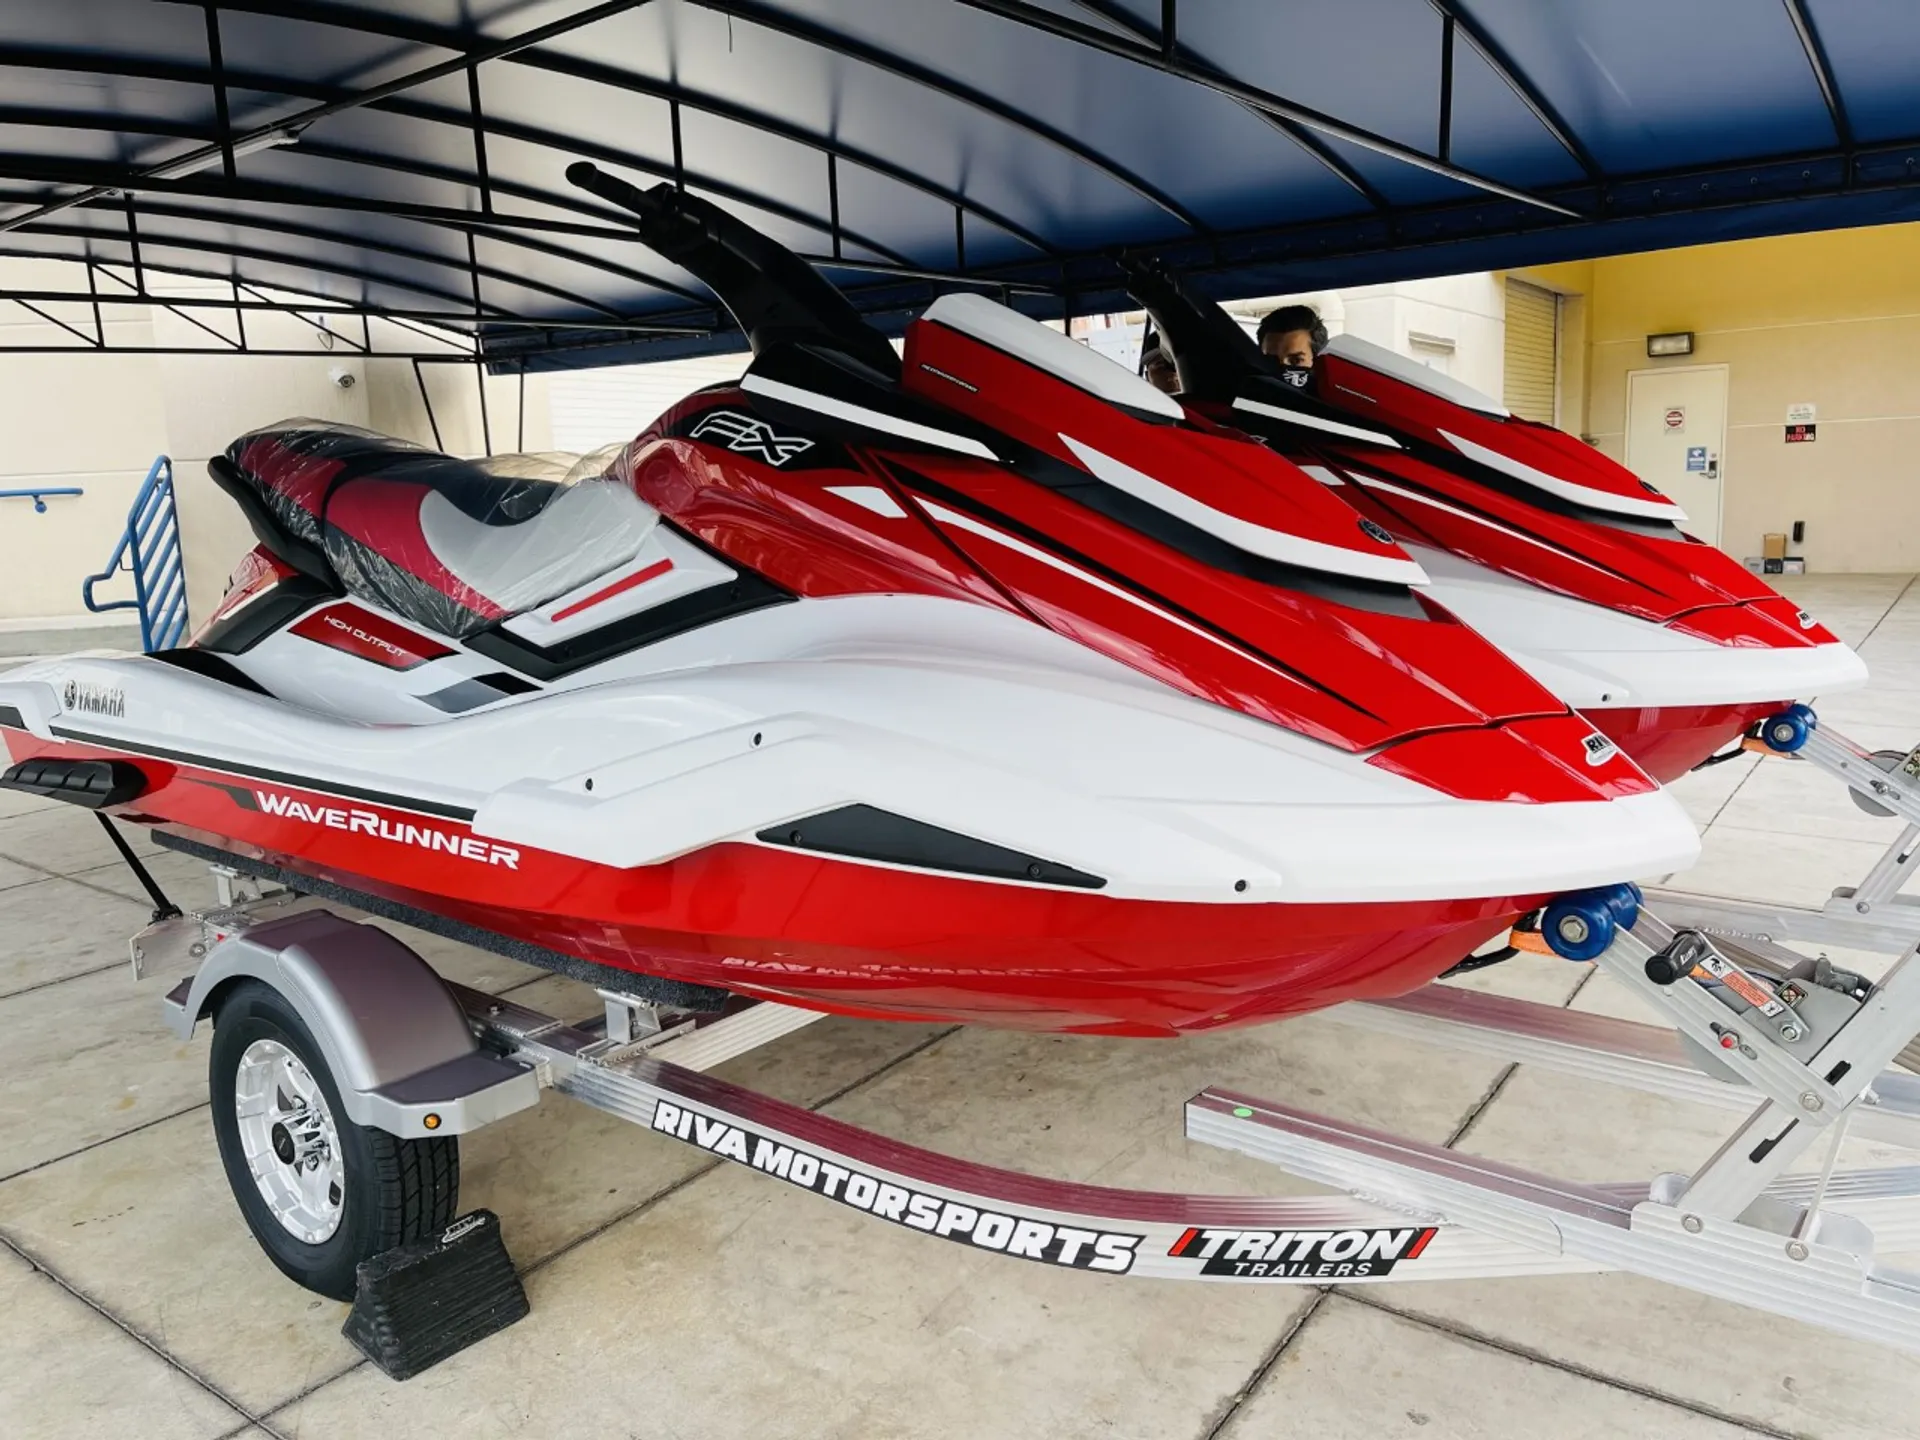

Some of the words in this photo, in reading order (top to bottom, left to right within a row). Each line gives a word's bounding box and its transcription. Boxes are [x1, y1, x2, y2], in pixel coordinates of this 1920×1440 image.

[689, 410, 816, 466] FX
[323, 614, 352, 633] HIGH
[352, 628, 406, 657] OUTPUT
[79, 684, 125, 718] YAMAHA
[653, 1100, 749, 1164] RIVA
[751, 1138, 1141, 1273] MOTORSPORTS
[1198, 1229, 1415, 1262] TRITON
[1233, 1262, 1373, 1277] TRAILERS
